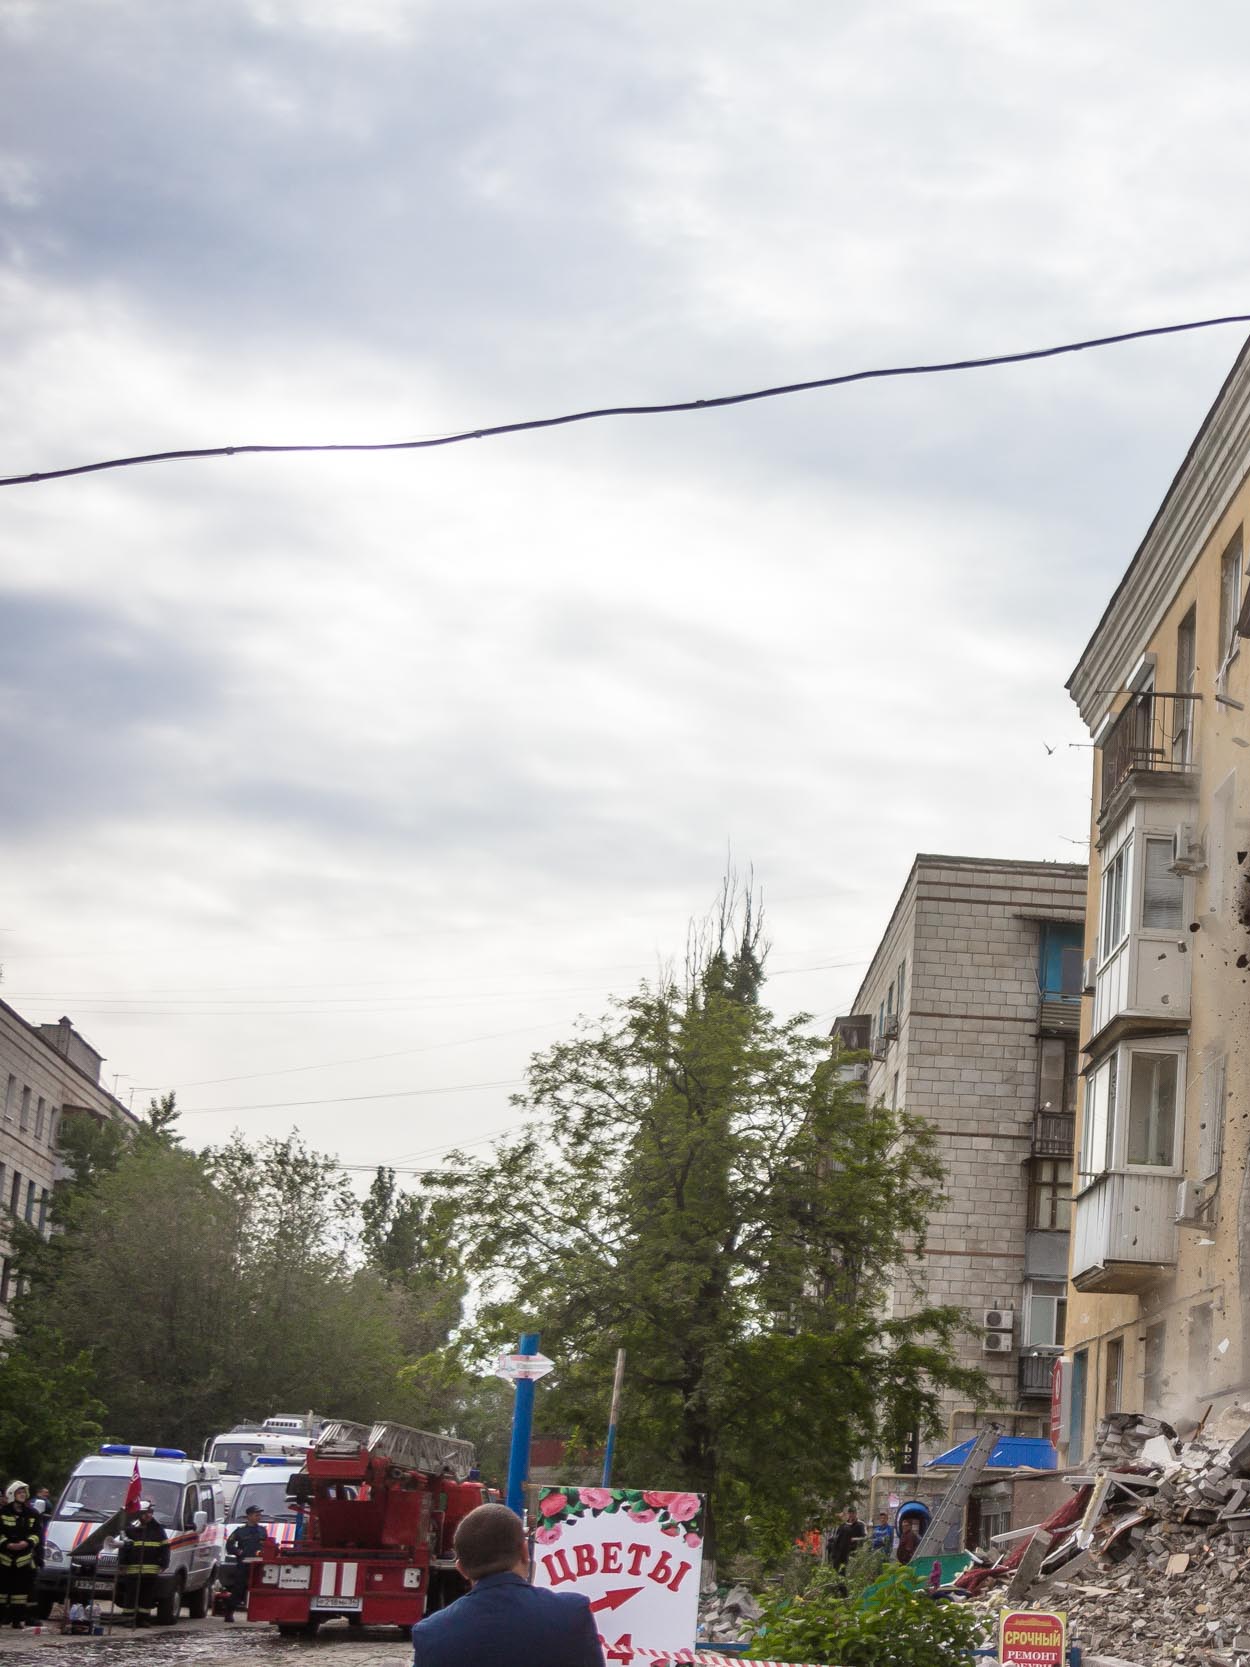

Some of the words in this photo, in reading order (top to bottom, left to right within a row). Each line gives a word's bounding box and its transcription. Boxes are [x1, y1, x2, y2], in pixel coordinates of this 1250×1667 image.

[541, 1541, 693, 1592] ЦВЕТЫ
[1005, 1629, 1061, 1647] СРОЧНЫЙ
[1007, 1650, 1057, 1661] РЕМОНТ
